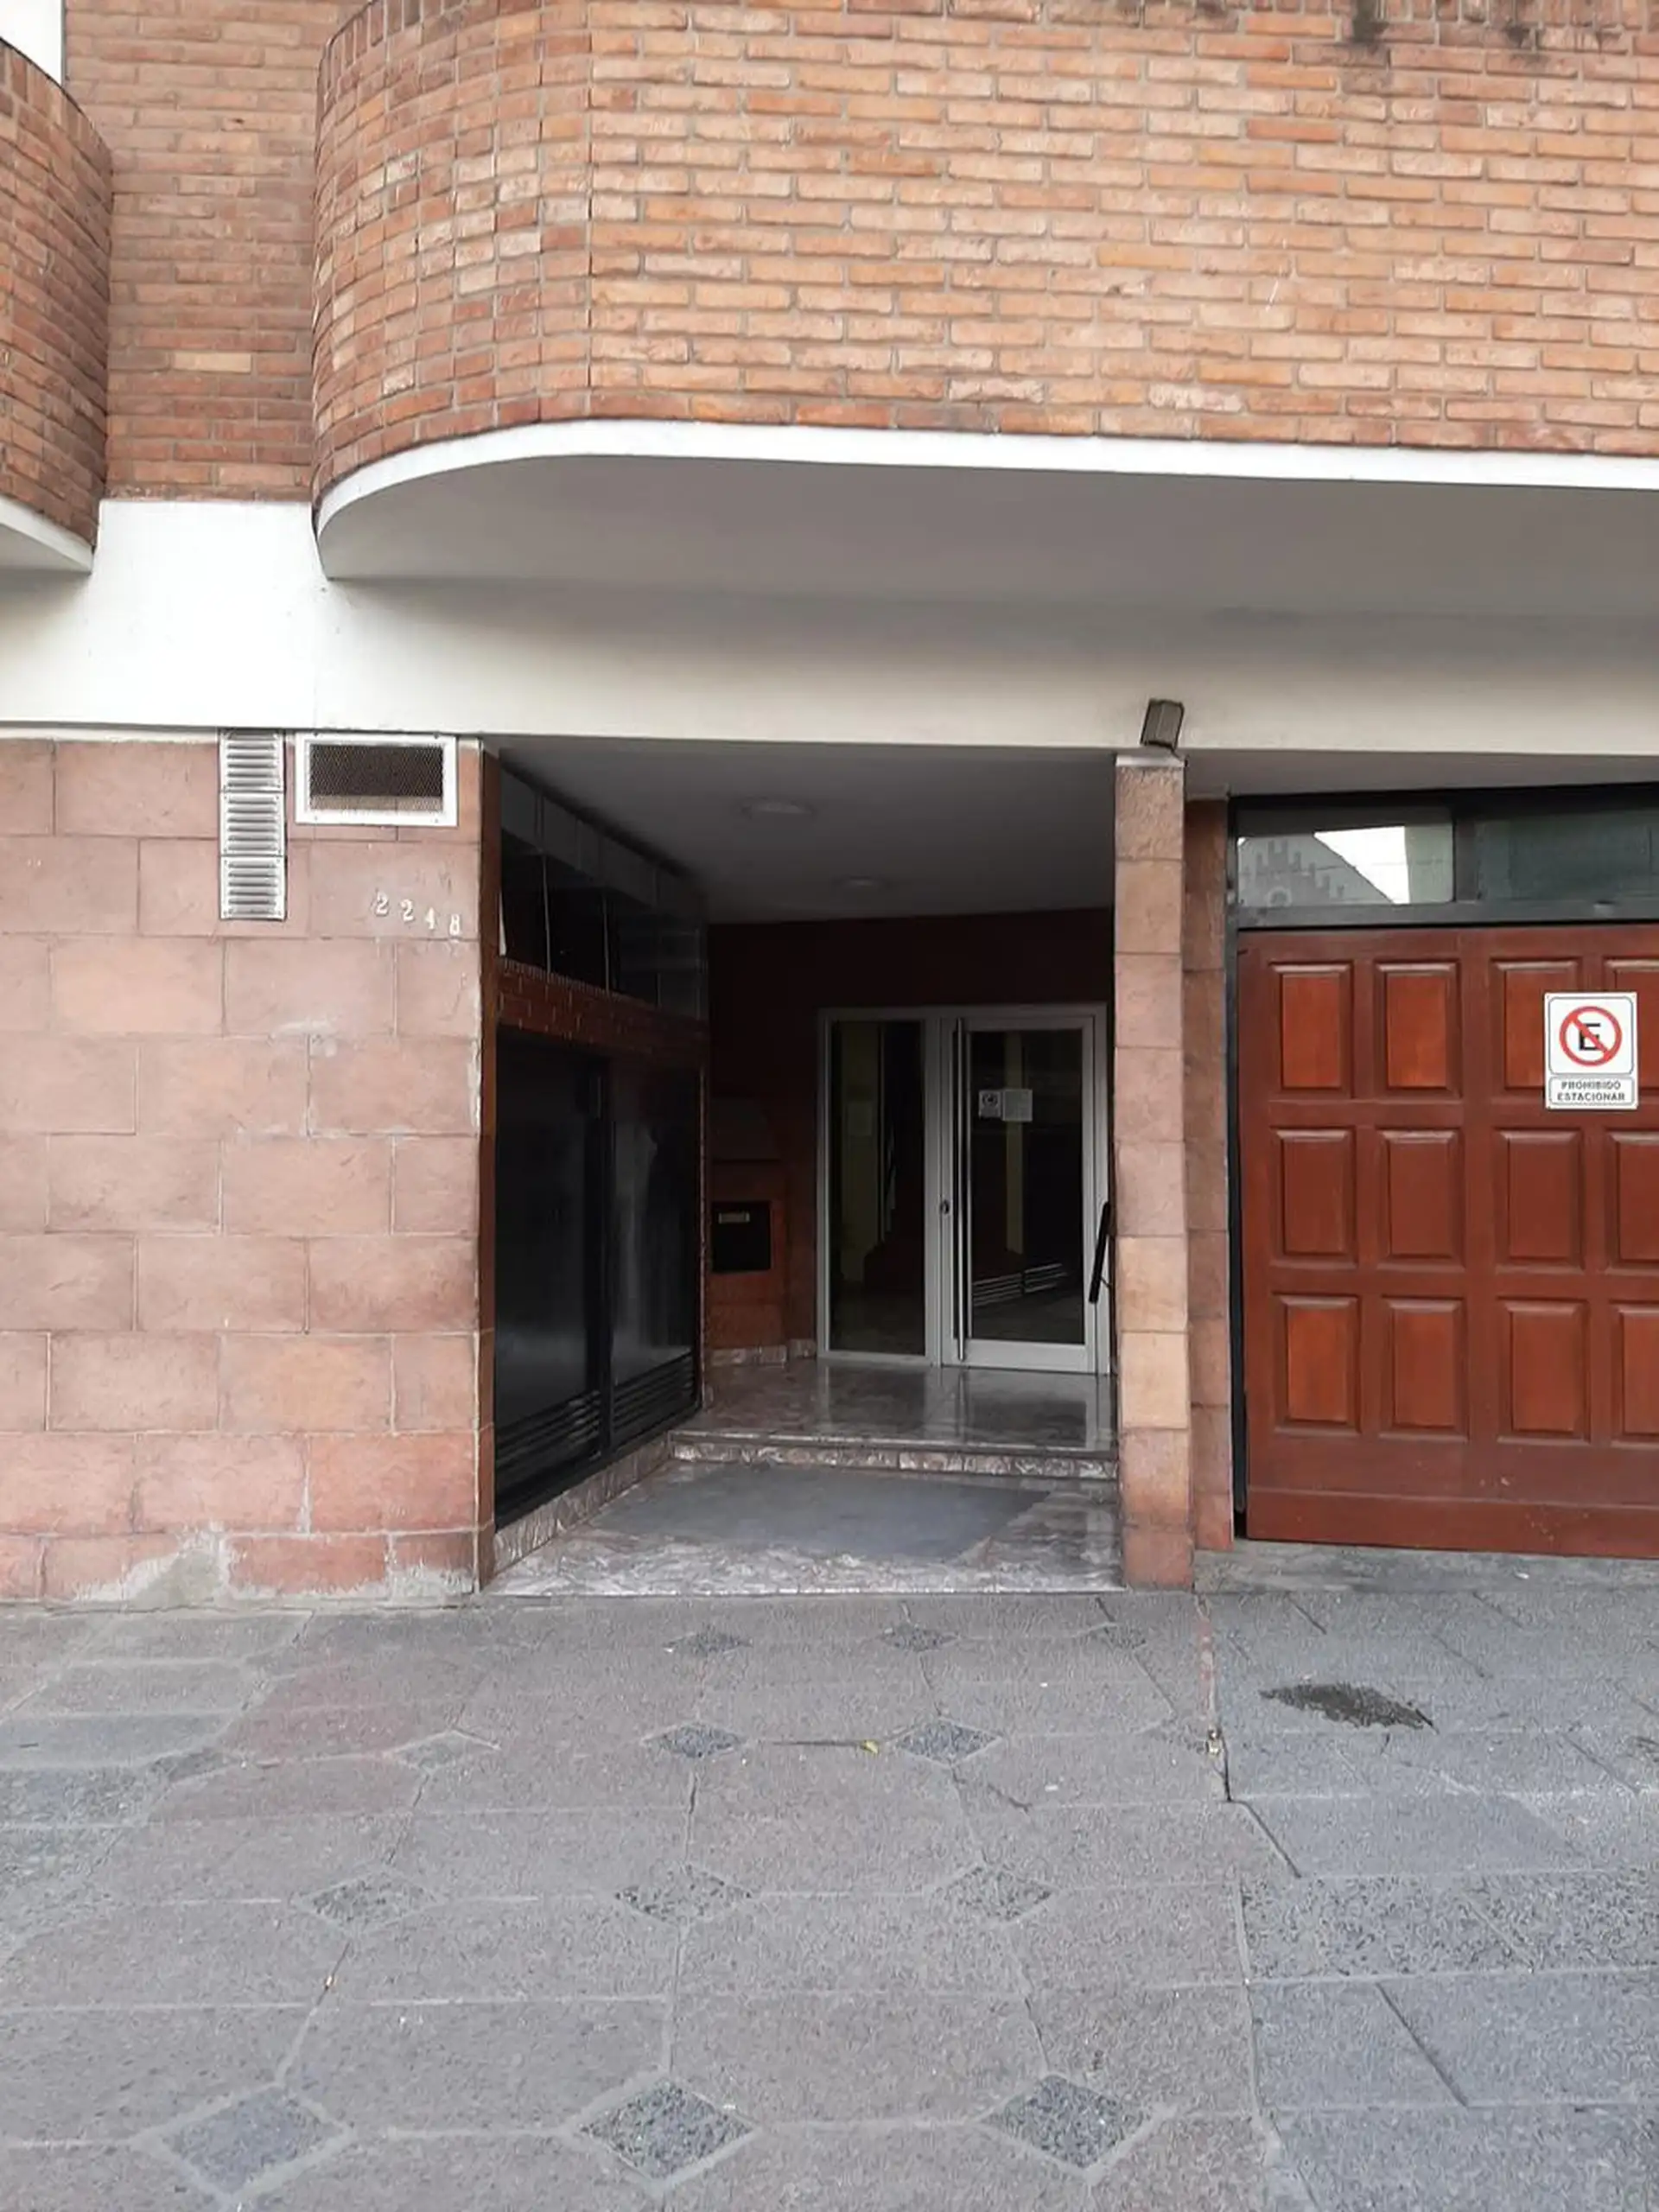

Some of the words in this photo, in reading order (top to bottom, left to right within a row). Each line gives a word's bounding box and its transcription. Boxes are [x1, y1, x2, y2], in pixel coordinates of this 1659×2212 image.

[374, 892, 461, 935] 2248
[1579, 1023, 1601, 1051] E
[1561, 1081, 1621, 1090] PROHIBIDO
[1557, 1092, 1625, 1101] ESTACIONAR
